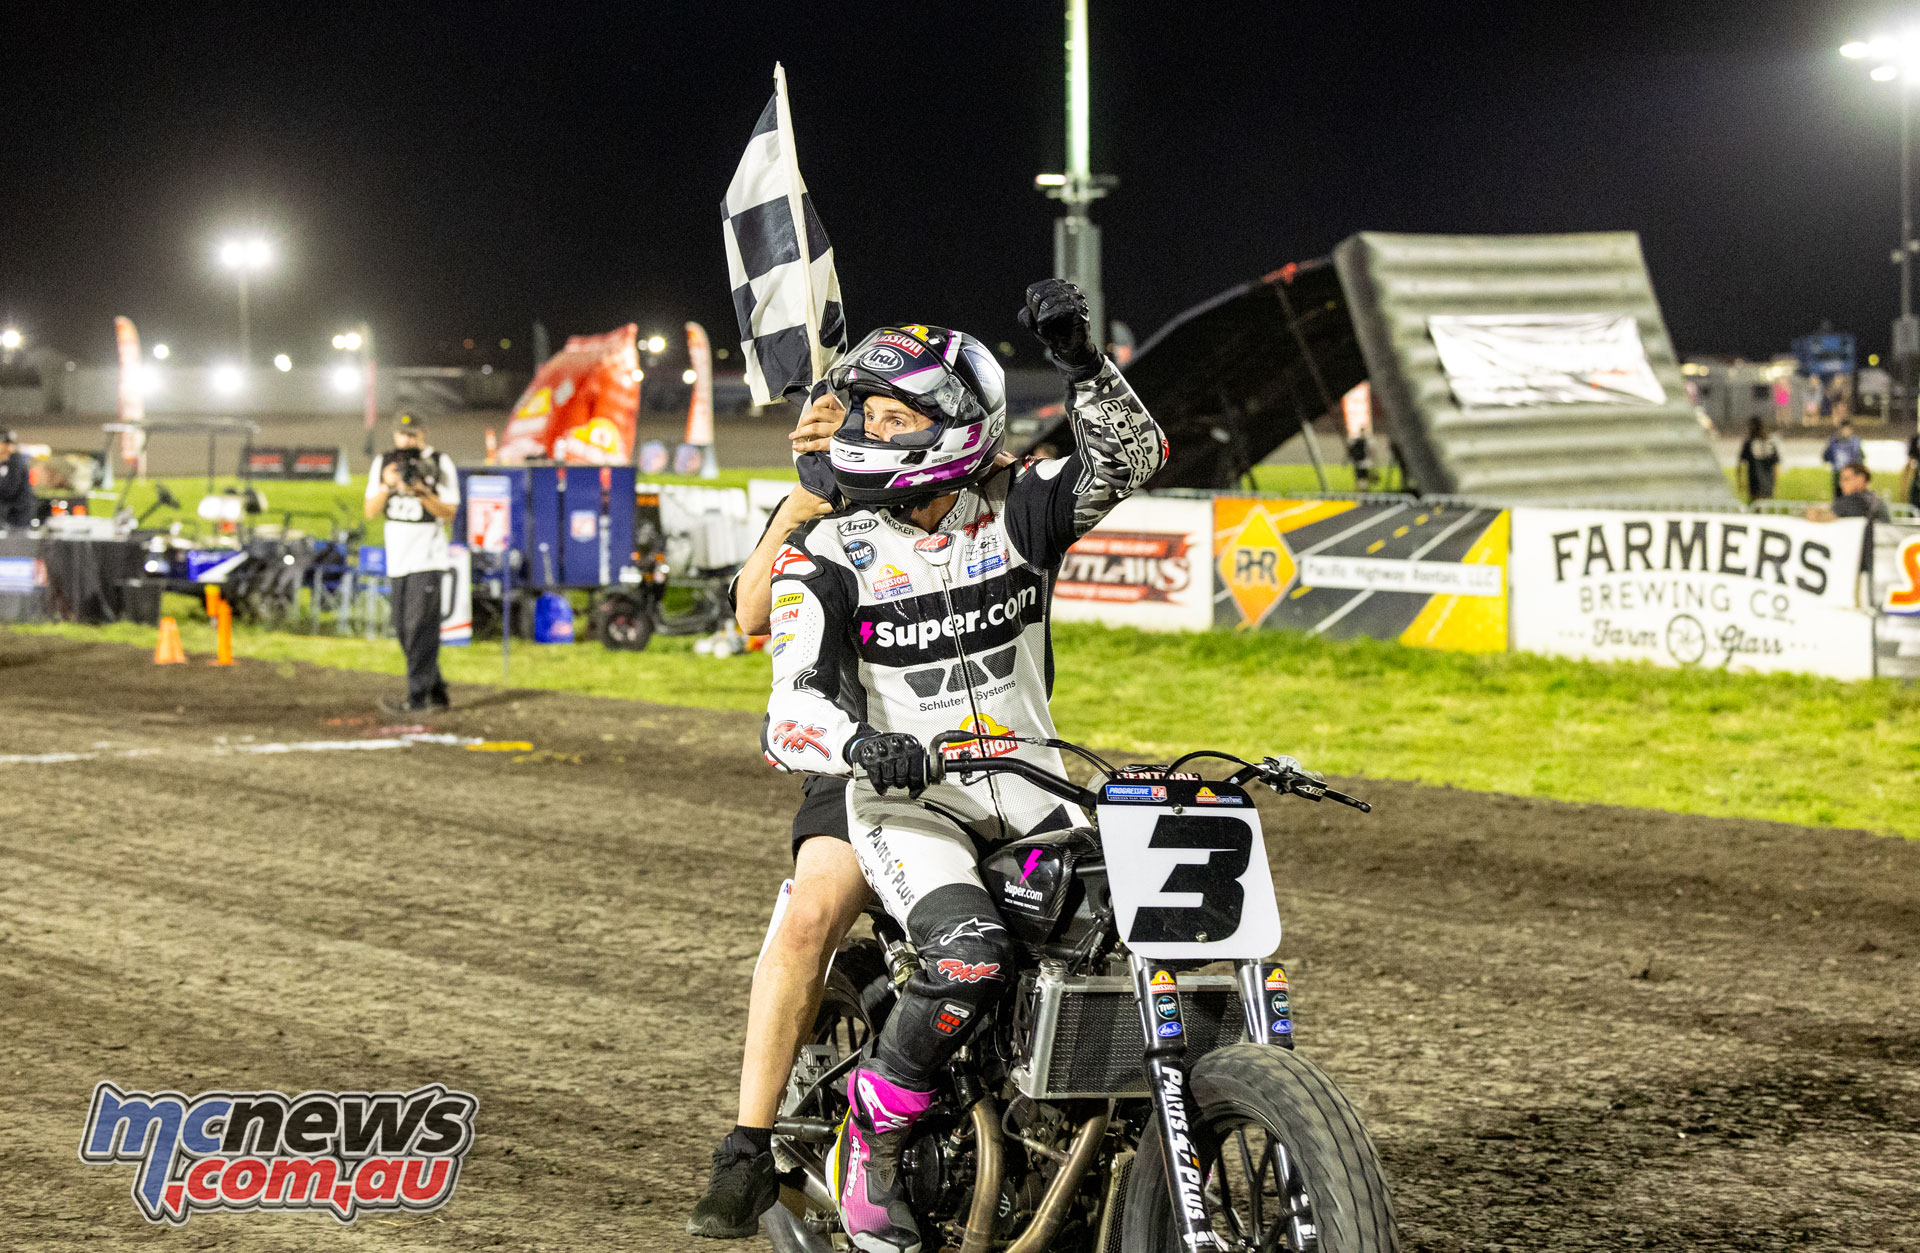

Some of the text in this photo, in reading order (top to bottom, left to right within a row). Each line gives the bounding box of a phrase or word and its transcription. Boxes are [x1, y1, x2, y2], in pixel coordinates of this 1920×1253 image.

[867, 349, 896, 366] Arai
[962, 423, 982, 449] 3
[845, 519, 873, 532] Arai
[886, 519, 915, 536] KICKER
[1552, 521, 1831, 596] FARMERS
[875, 575, 909, 590] mission
[1058, 555, 1190, 592] UTLAWS
[1580, 581, 1731, 612] BREWING
[875, 585, 1037, 651] Super.com
[1108, 786, 1150, 796] PROGRESSIVE
[1004, 880, 1043, 902] Super.com
[1128, 814, 1254, 943] 3
[1161, 1066, 1189, 1132] PARTS
[1179, 1165, 1206, 1220] PLUS
